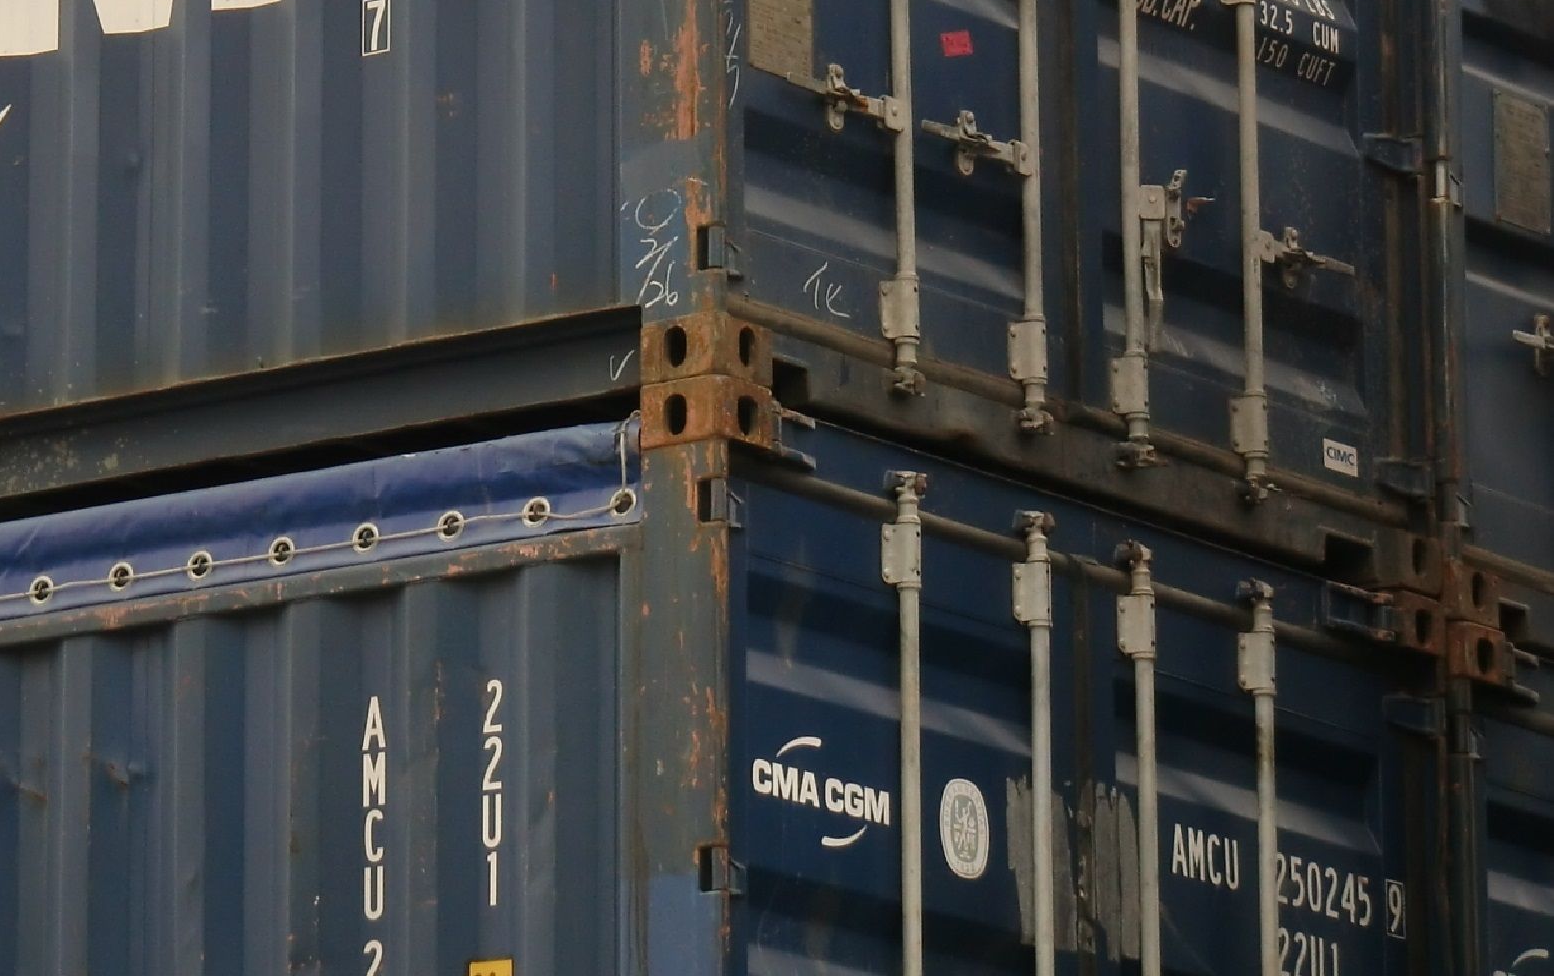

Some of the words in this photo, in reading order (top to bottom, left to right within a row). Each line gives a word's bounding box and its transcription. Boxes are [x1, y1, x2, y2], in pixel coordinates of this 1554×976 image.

[1258, 0, 1294, 35] 32.5
[1311, 21, 1341, 55] CUM
[1325, 445, 1356, 467] CIMC
[361, 695, 387, 921] AMCU
[482, 679, 503, 907] 22U1
[752, 758, 820, 808] CMA
[824, 777, 890, 826] CGM
[1171, 822, 1240, 891] AMCU
[1276, 851, 1374, 928] 250245
[1386, 881, 1404, 936] 9
